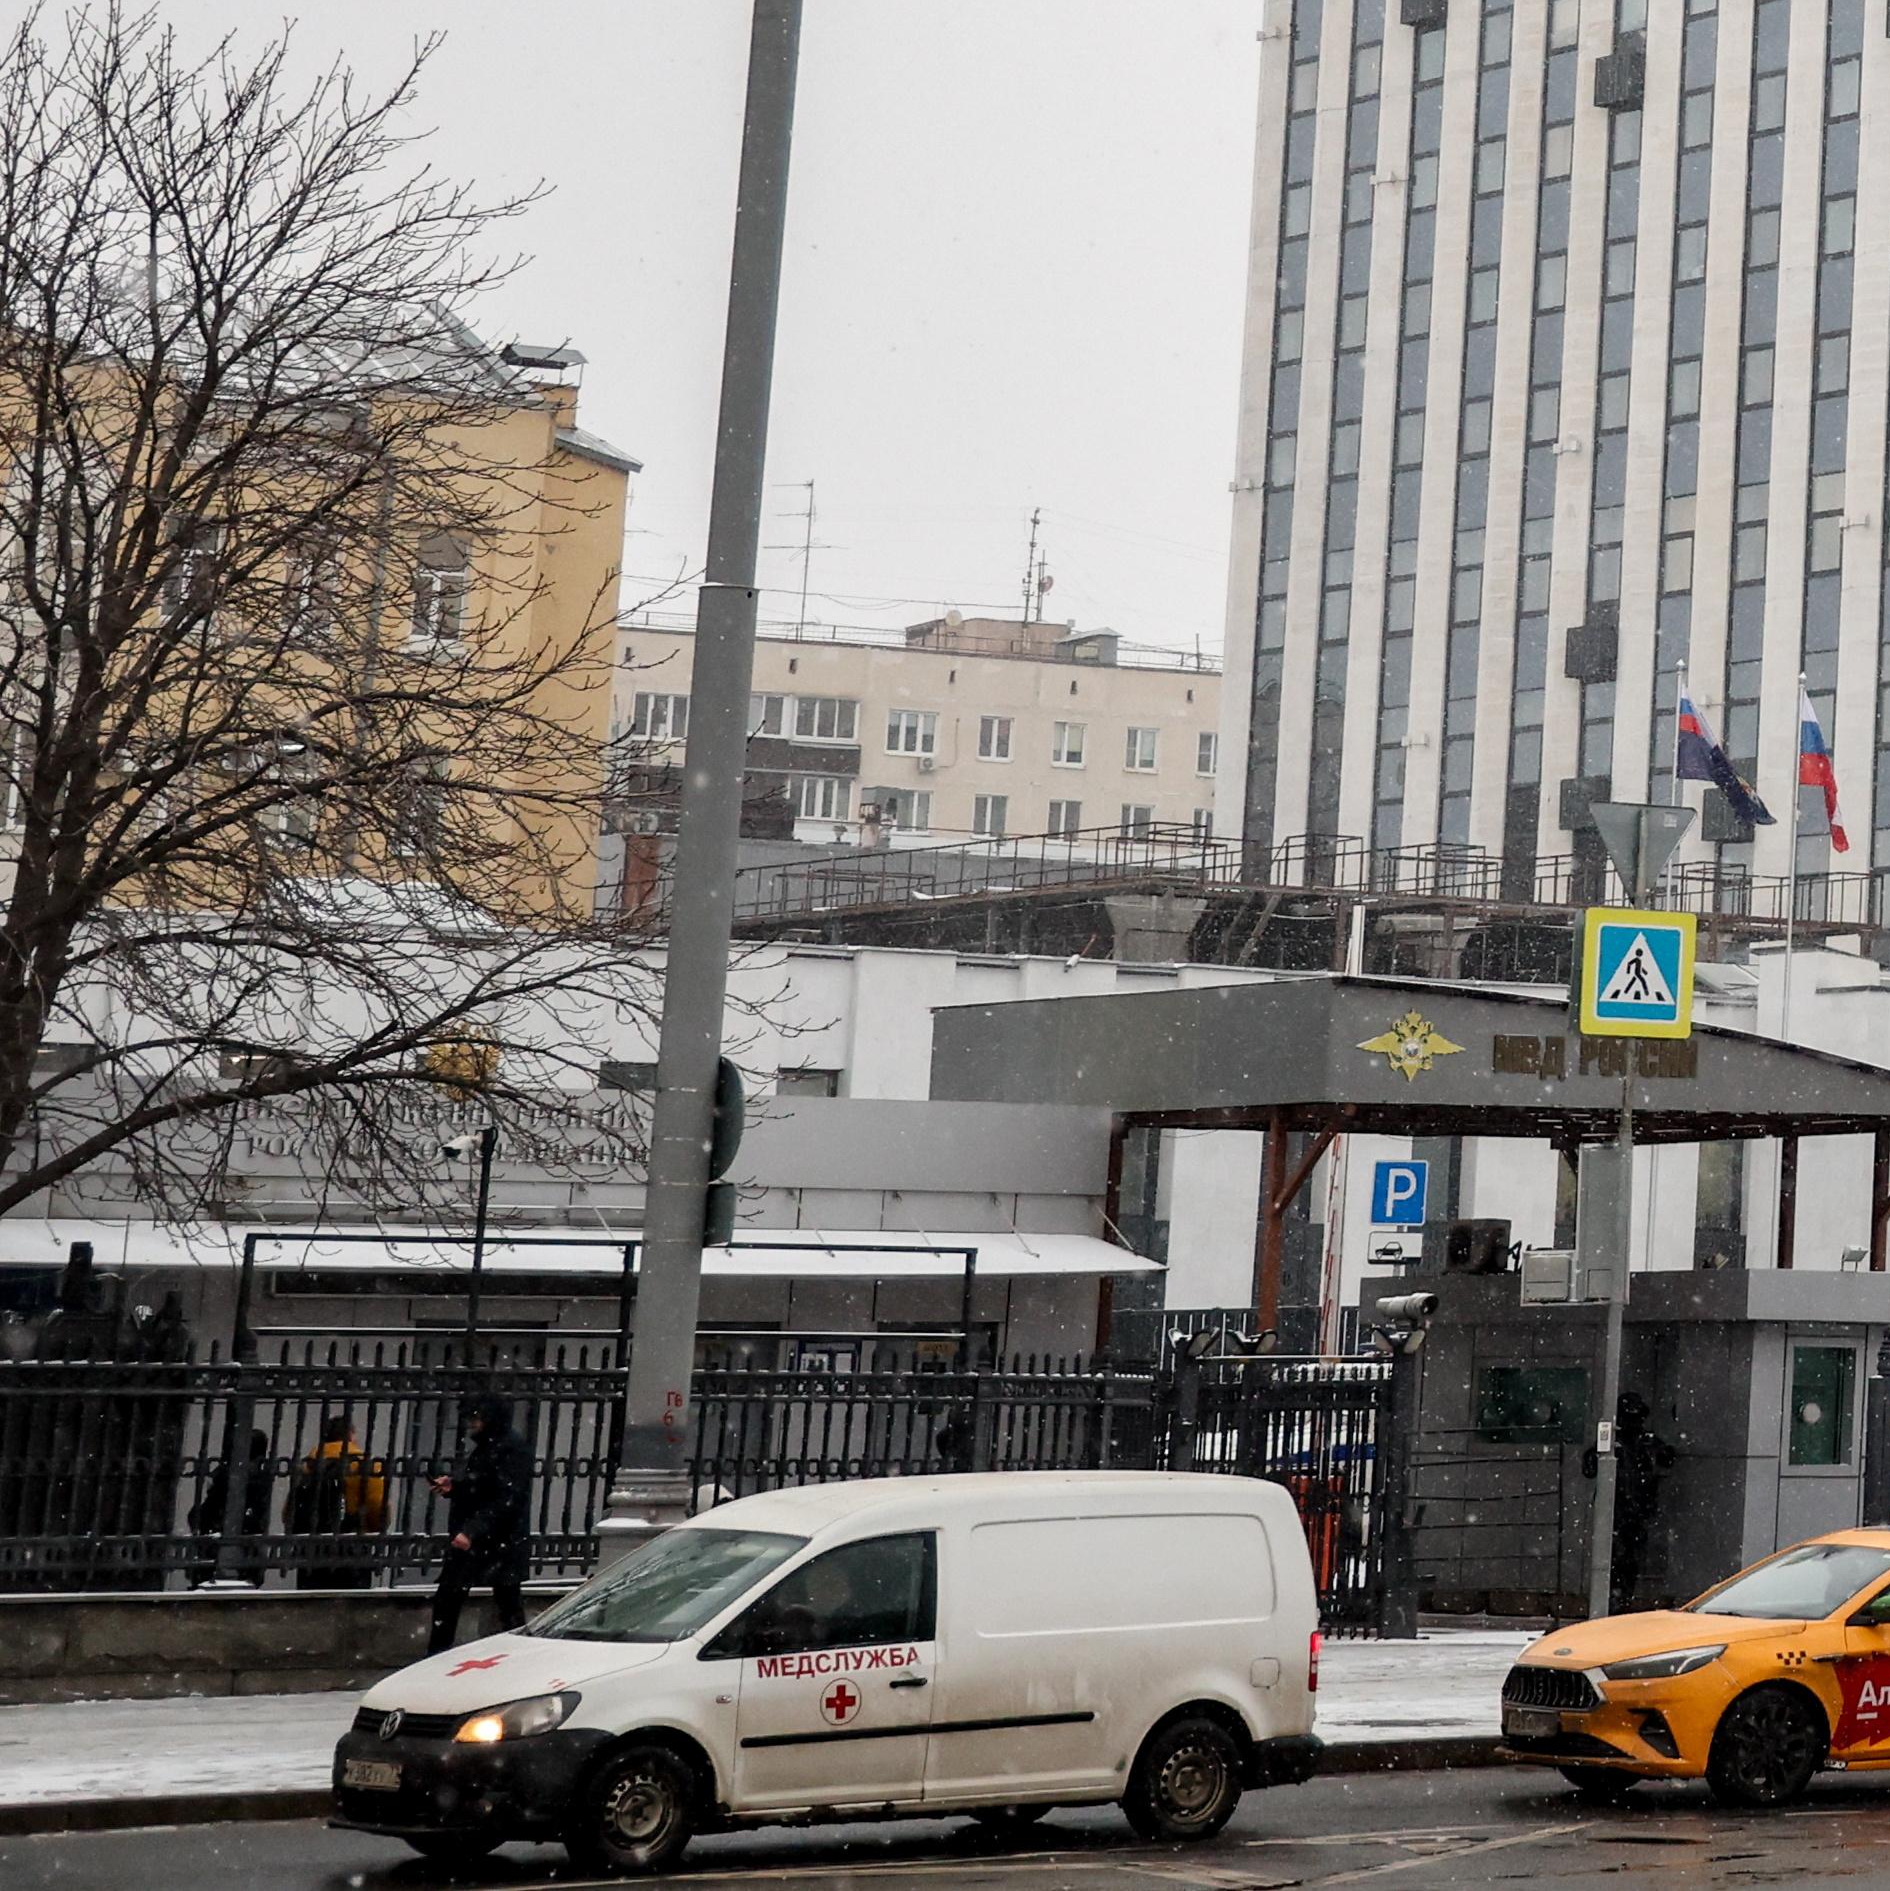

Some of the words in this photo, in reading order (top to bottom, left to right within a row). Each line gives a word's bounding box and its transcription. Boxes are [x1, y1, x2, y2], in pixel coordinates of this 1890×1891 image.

[1494, 1034, 1566, 1081] МВД
[1386, 1168, 1417, 1217] P
[757, 1646, 921, 1679] МЕДСЛУЖБА
